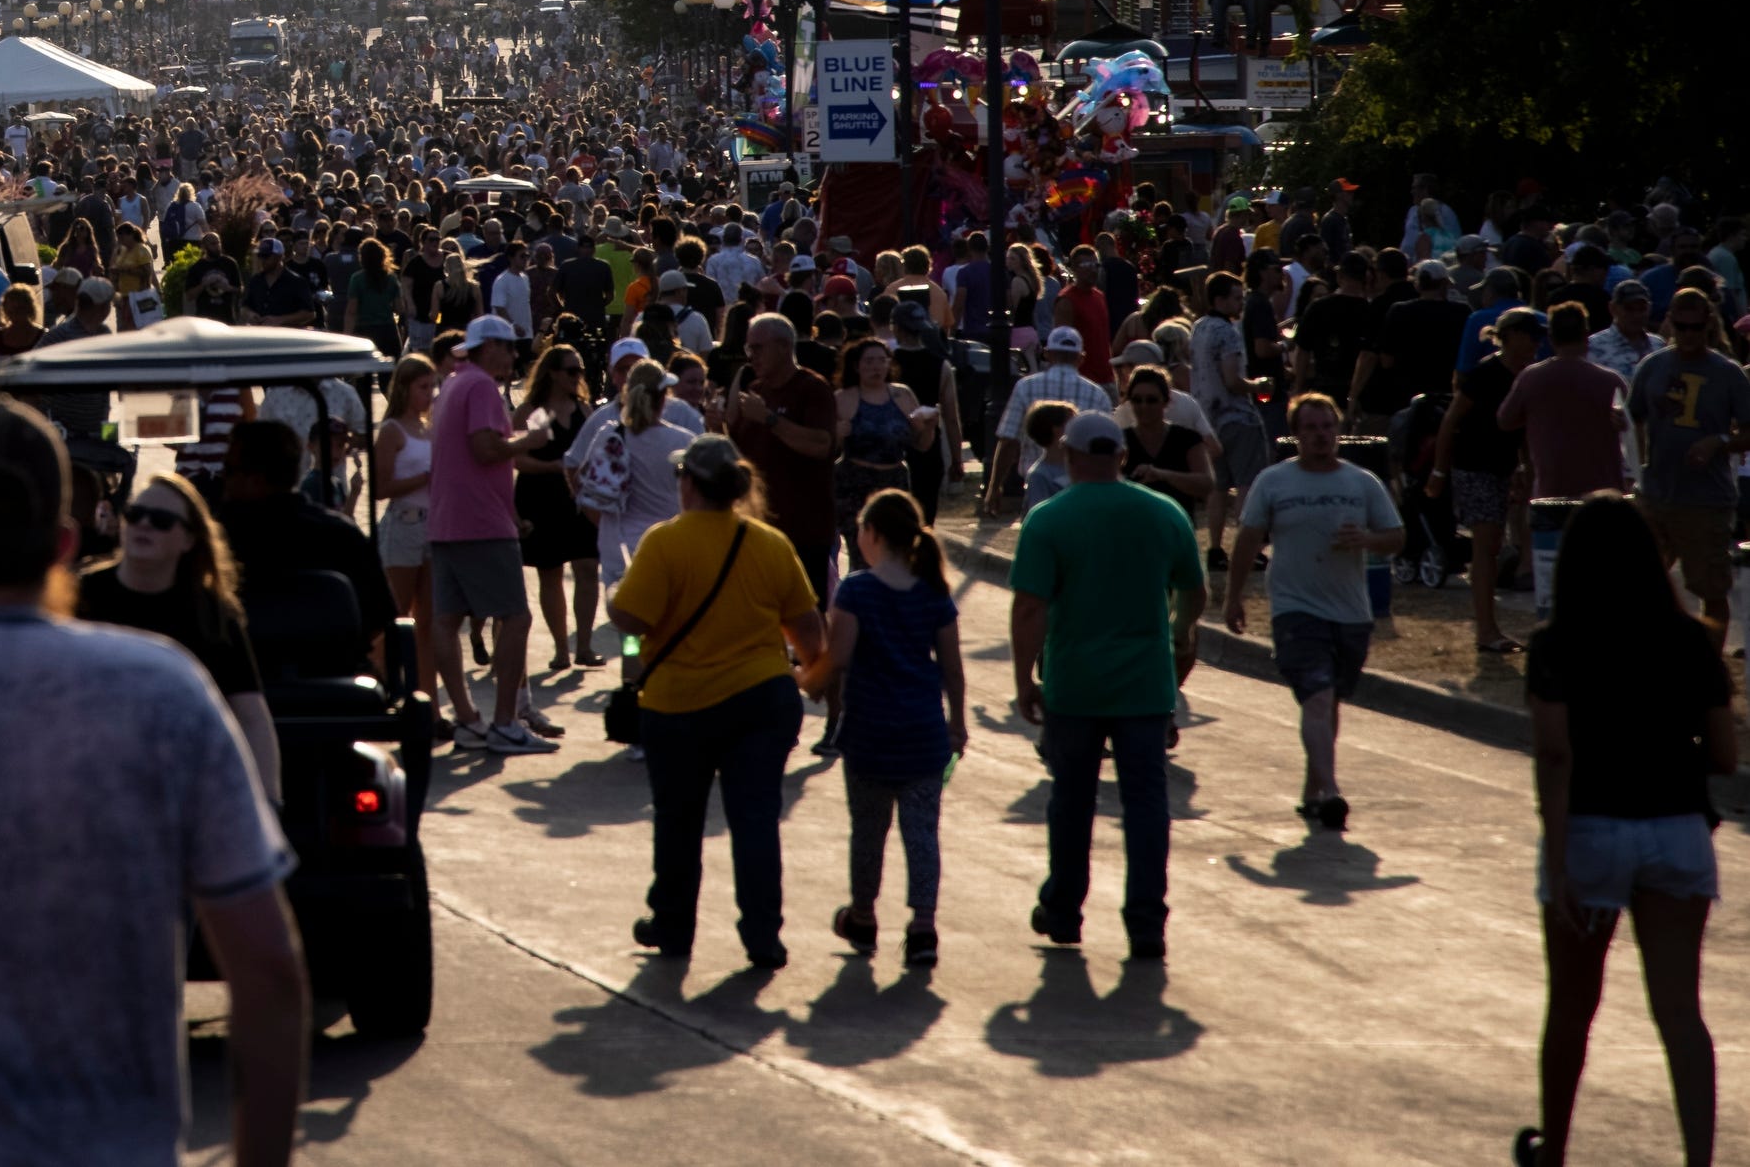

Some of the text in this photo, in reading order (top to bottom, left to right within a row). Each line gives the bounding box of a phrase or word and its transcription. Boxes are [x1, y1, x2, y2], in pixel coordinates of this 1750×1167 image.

[1028, 14, 1043, 27] 19
[824, 56, 886, 72] BLUE
[831, 76, 883, 92] LINE
[831, 113, 880, 121] PARKING
[832, 121, 880, 130] SHUTTLE
[750, 170, 784, 183] ATM
